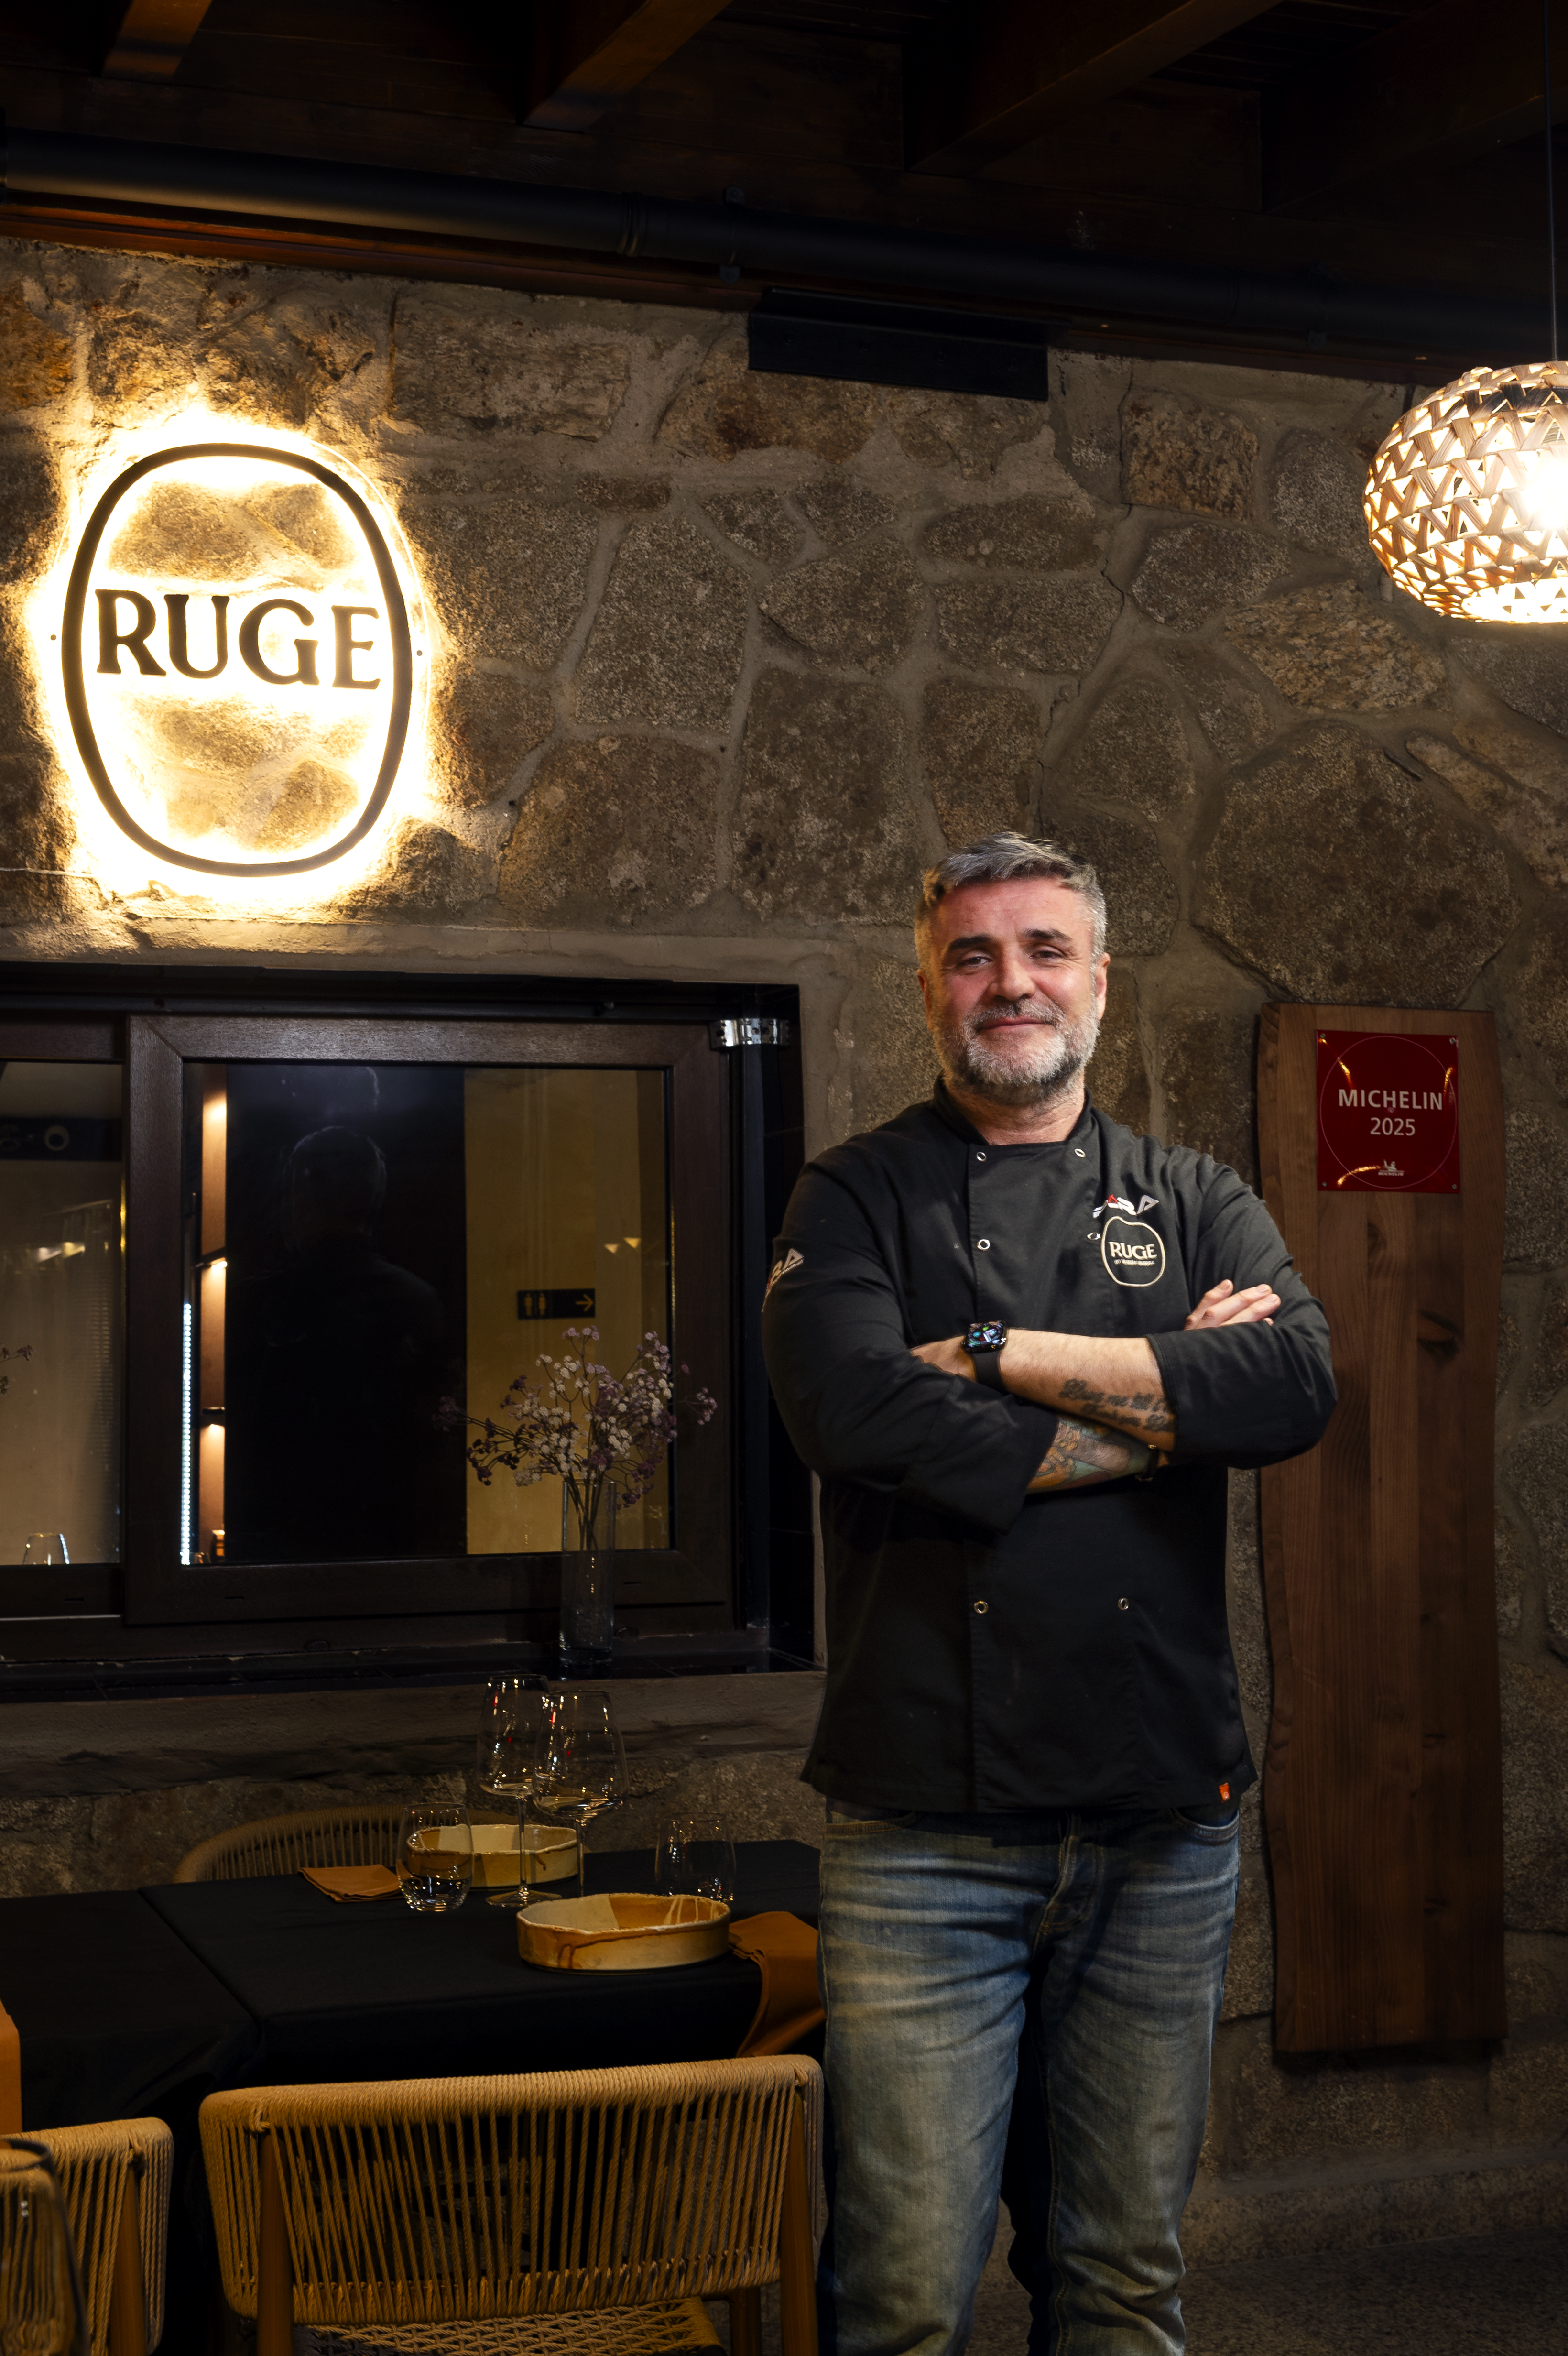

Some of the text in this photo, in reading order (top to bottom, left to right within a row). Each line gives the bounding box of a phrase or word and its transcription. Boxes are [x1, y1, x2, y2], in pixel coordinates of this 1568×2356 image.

[95, 589, 381, 690] RUGE
[1338, 1089, 1442, 1110] MICHELIN
[1370, 1117, 1416, 1136] 2025
[1108, 1241, 1157, 1260] RUGE
